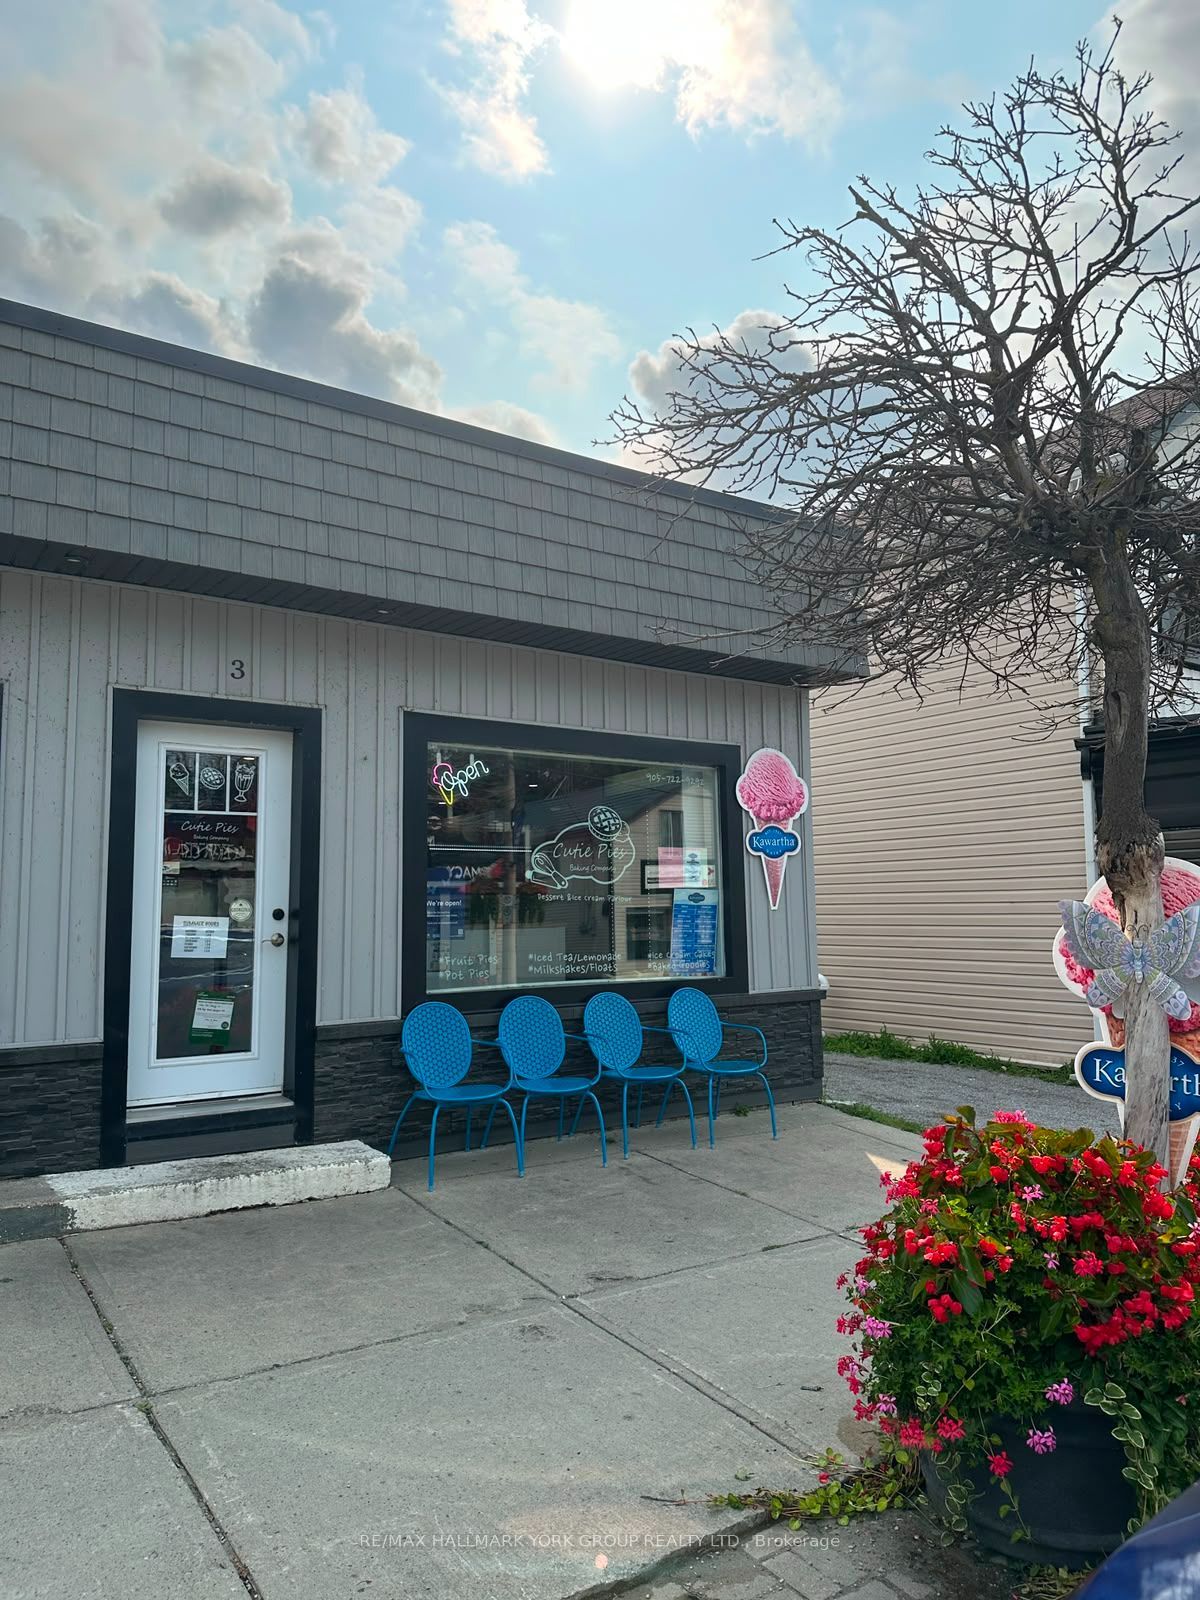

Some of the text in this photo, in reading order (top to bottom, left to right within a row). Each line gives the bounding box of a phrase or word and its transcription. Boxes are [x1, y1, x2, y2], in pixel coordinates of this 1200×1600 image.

[231, 660, 245, 680] 3
[441, 761, 490, 797] Open
[181, 820, 240, 834] Cutie Pies
[752, 836, 795, 848] Kawartha
[553, 842, 625, 860] Cutie Pies
[427, 900, 462, 908] We're open!
[537, 893, 563, 903] Dessert
[477, 953, 498, 965] Pies
[445, 968, 490, 981] Pot Pies
